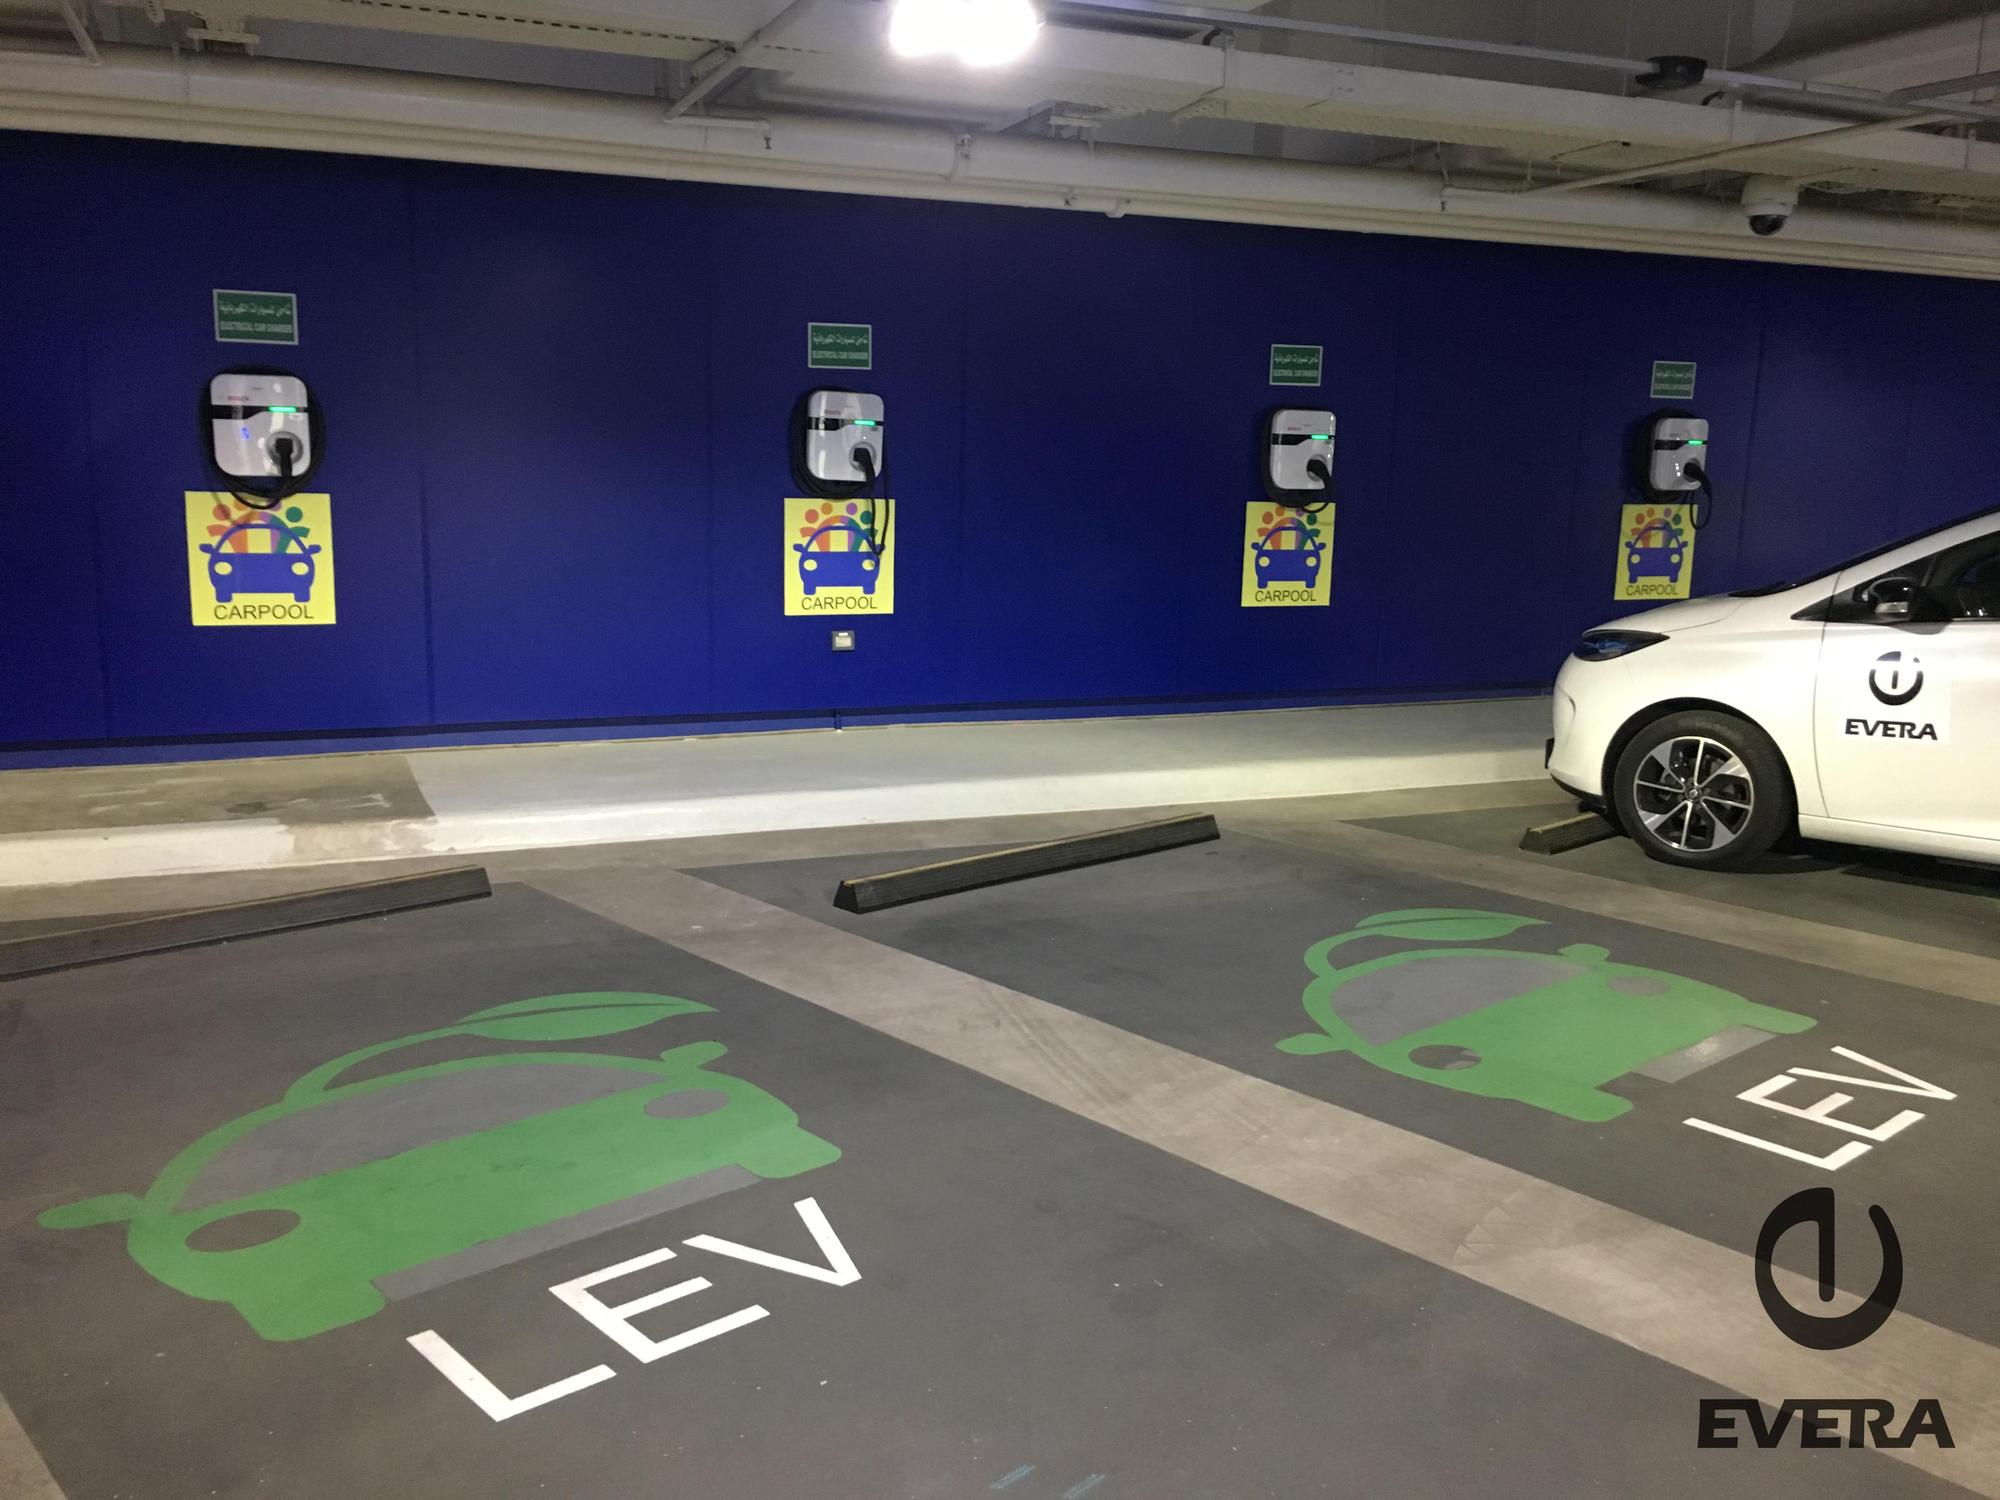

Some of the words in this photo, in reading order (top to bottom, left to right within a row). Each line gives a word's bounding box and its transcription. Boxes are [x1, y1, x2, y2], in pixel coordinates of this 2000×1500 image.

[1255, 590, 1317, 602] CARPOOL
[1625, 584, 1678, 596] CARPOOL
[801, 596, 878, 610] CARPOOL
[214, 604, 314, 620] CARPOOL
[1845, 718, 1938, 740] EVERA
[1682, 1045, 1958, 1171] LEV
[406, 1197, 862, 1422] LEV
